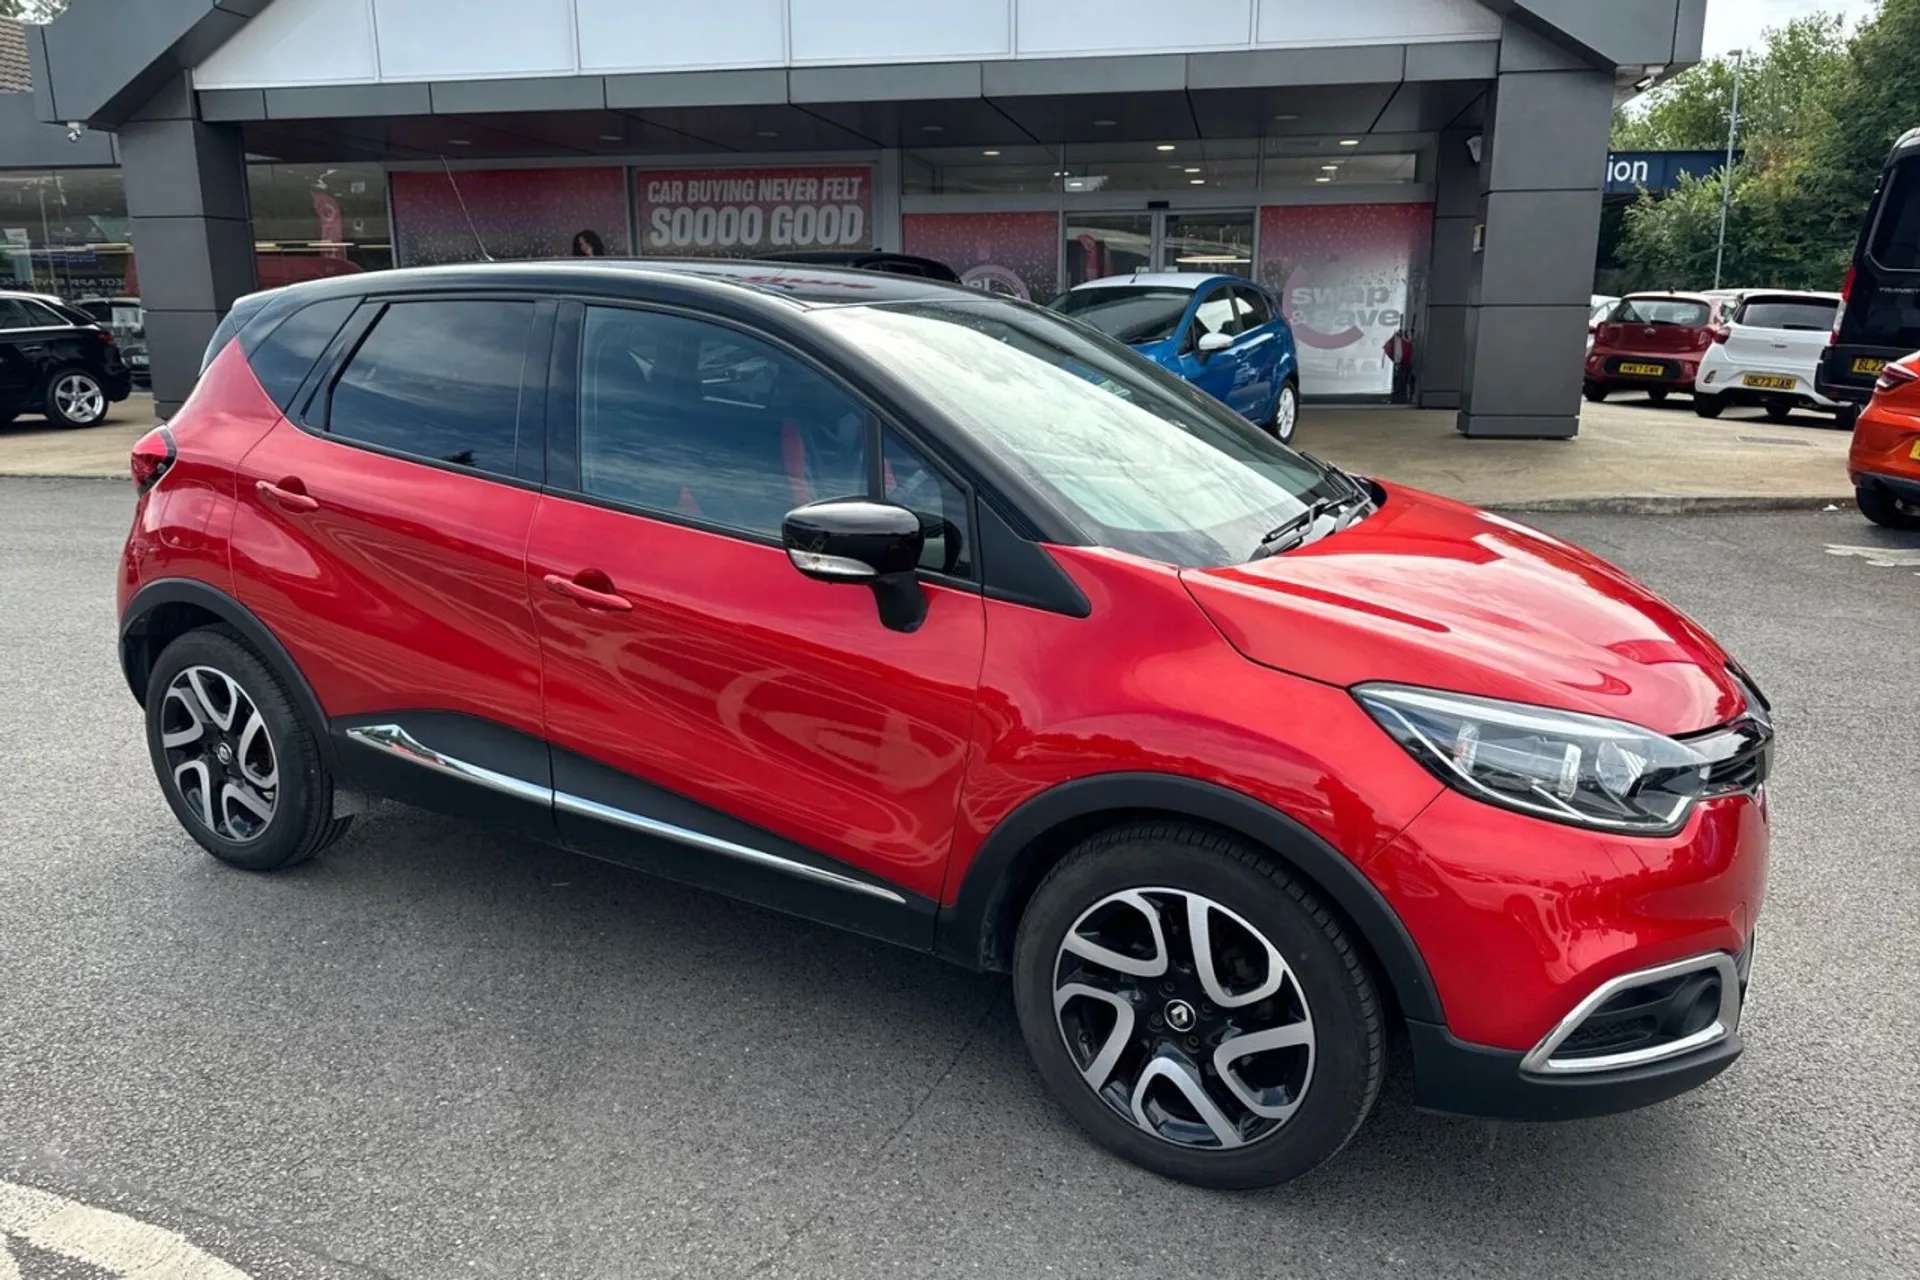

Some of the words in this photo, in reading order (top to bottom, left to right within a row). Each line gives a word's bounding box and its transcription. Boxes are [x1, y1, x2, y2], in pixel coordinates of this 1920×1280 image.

[1607, 154, 1648, 182] ion
[648, 180, 684, 203] CAR
[687, 179, 754, 202] BUYING
[757, 178, 818, 200] NEVER
[821, 177, 862, 200] FELT
[650, 205, 763, 246] SOOOO
[770, 204, 864, 245] GOOD
[1290, 286, 1390, 307] swap
[1311, 308, 1401, 326] save
